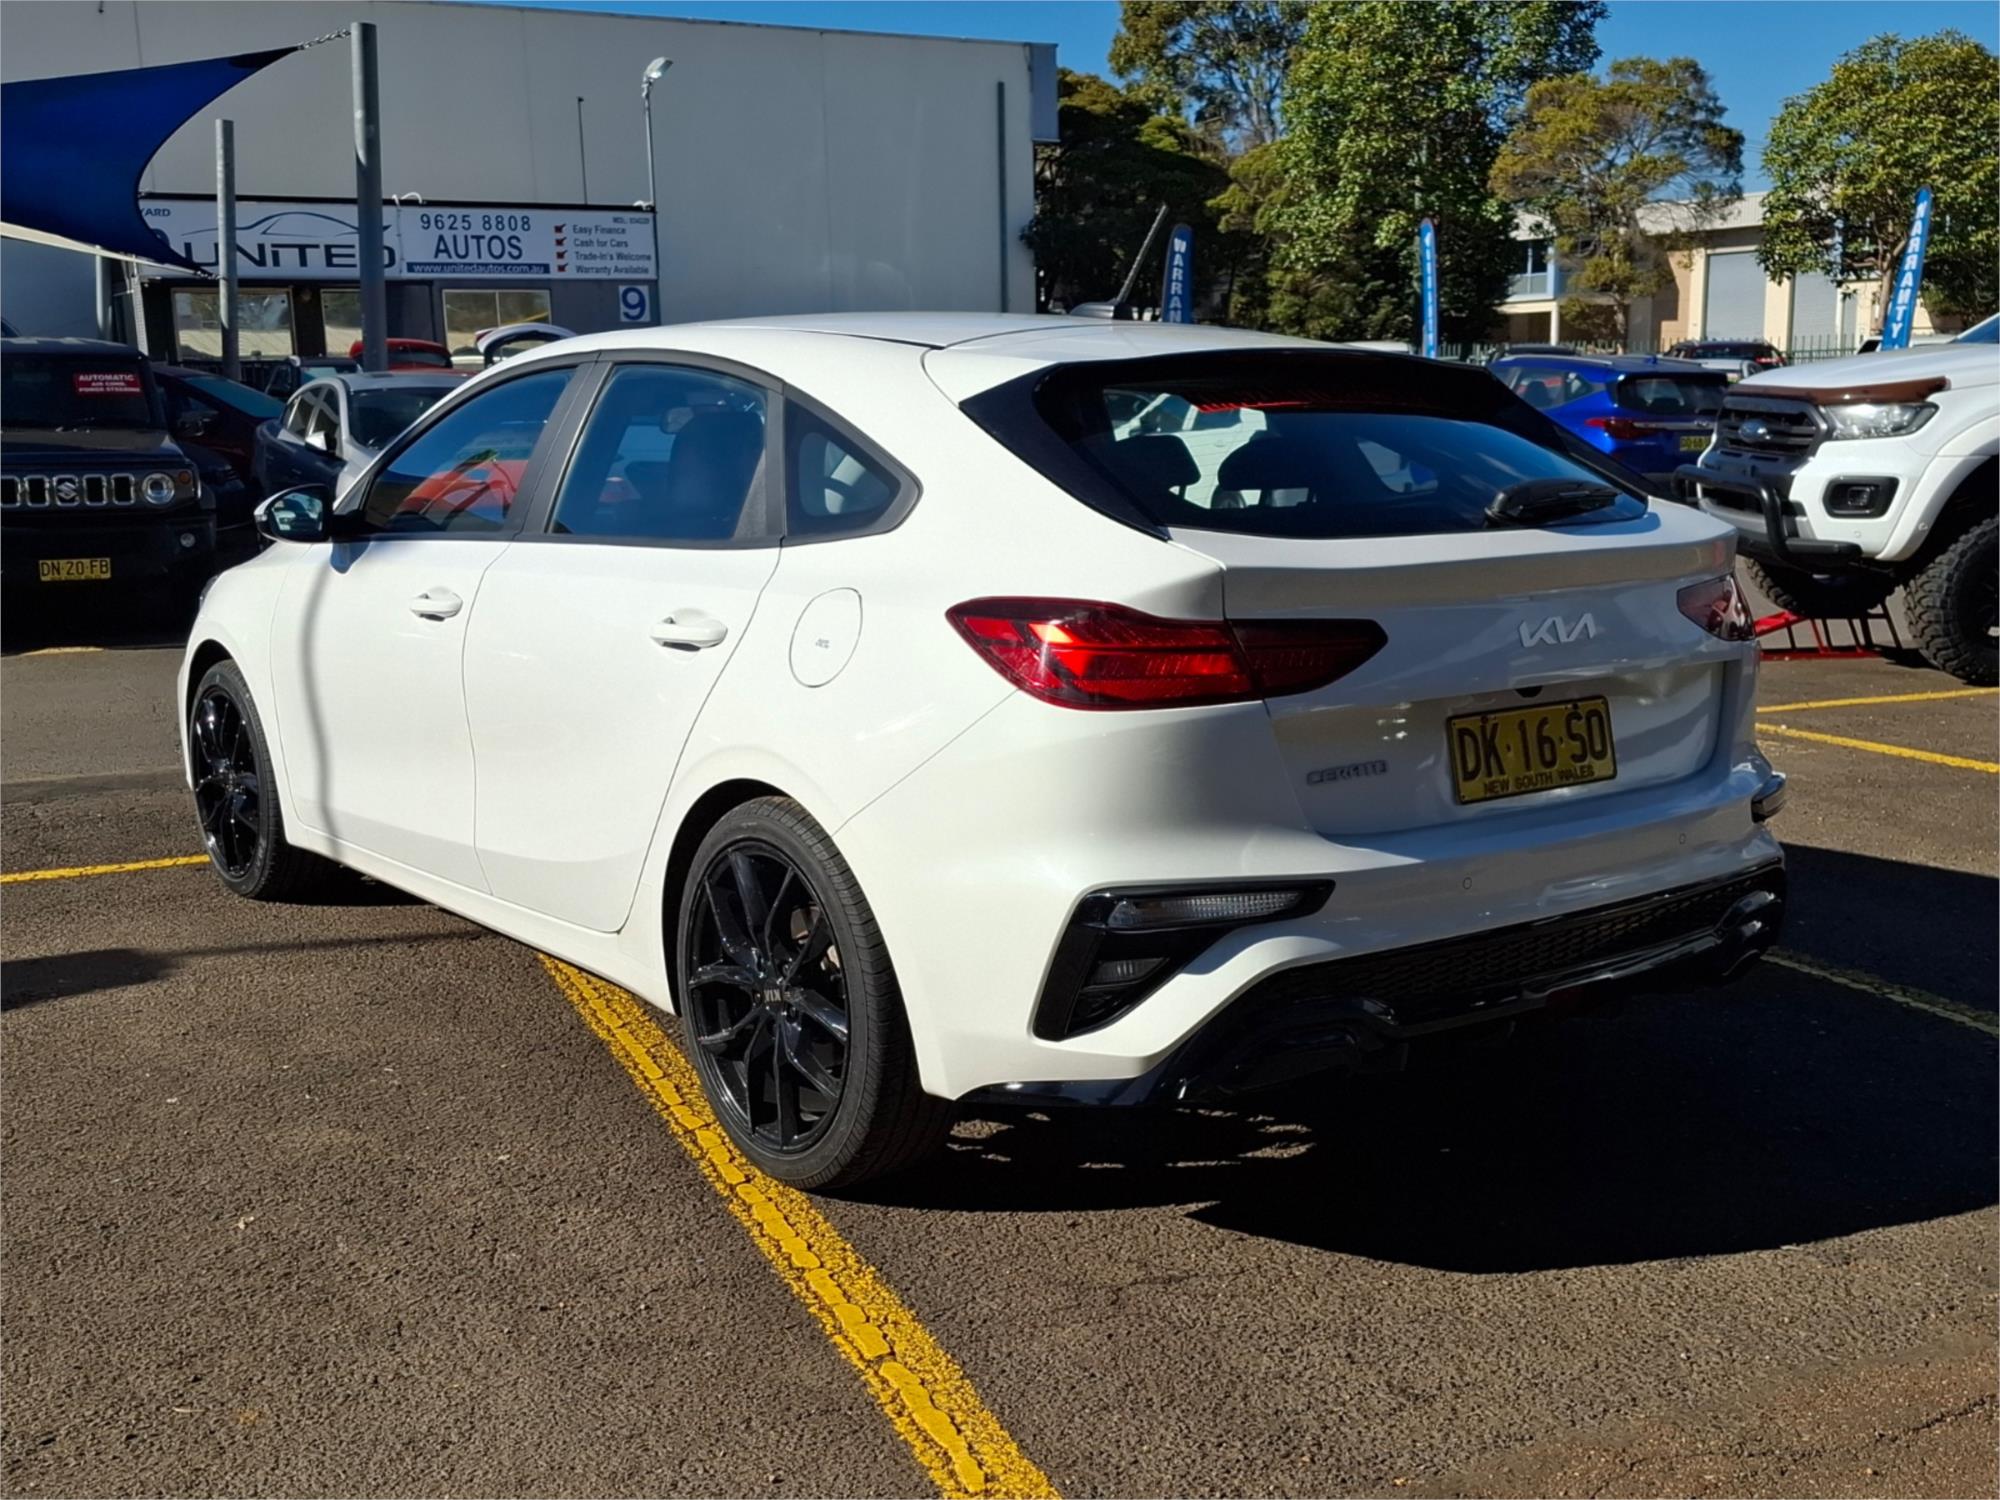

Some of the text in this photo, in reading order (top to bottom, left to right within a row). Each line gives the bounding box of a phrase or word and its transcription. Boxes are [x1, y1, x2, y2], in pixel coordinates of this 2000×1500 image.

[420, 213, 532, 232] 9625 8808
[572, 224, 627, 236] Easy Finance
[433, 234, 523, 260] AUTOS
[573, 238, 629, 249] Cash for Cars
[616, 252, 652, 262] Welcome
[412, 263, 545, 274] www.unitedautos.com.au
[575, 265, 649, 276] Warranty Available
[1890, 201, 1928, 339] WARRANTY
[621, 286, 646, 321] 9
[79, 373, 135, 381] AUTOMATIC
[1518, 612, 1597, 648] KIA
[1483, 764, 1595, 796] NEW SOUTH WALES
